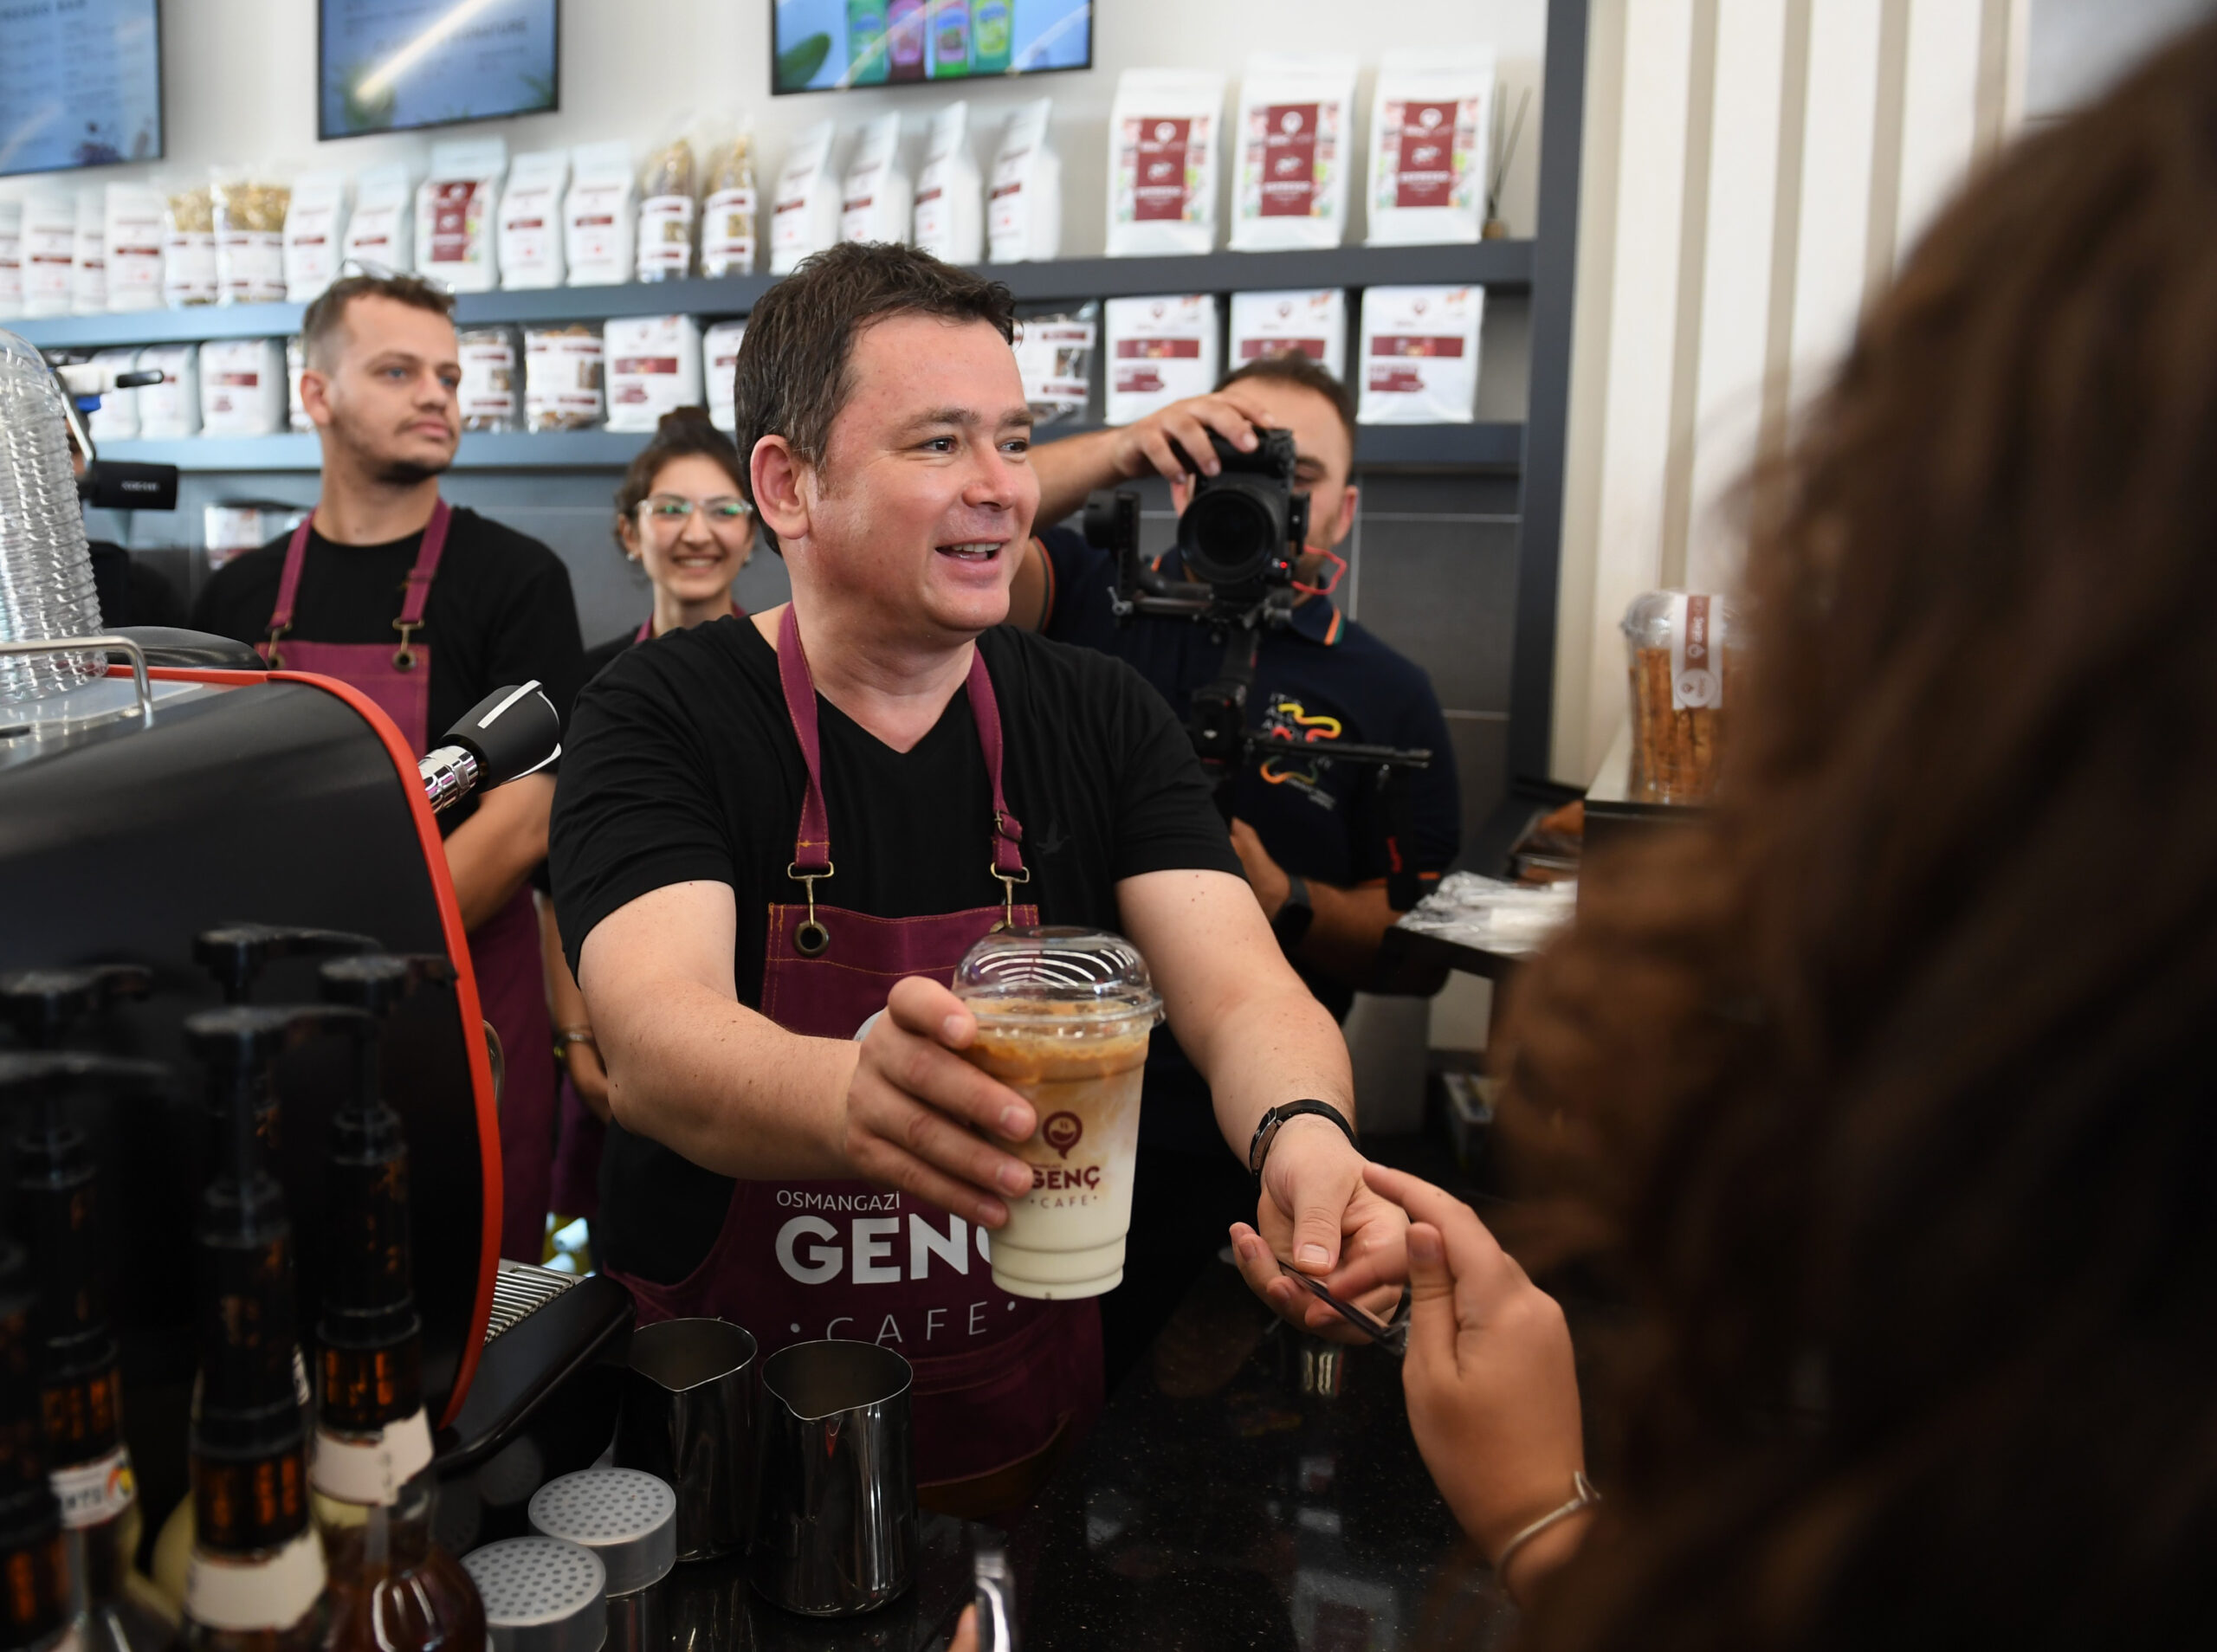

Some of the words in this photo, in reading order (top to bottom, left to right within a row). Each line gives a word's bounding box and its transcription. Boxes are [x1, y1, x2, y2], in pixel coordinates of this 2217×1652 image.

[776, 1190, 901, 1211] OSMANGAZİ
[1040, 1195, 1088, 1210] CAFE
[825, 1301, 987, 1345] CAFE
